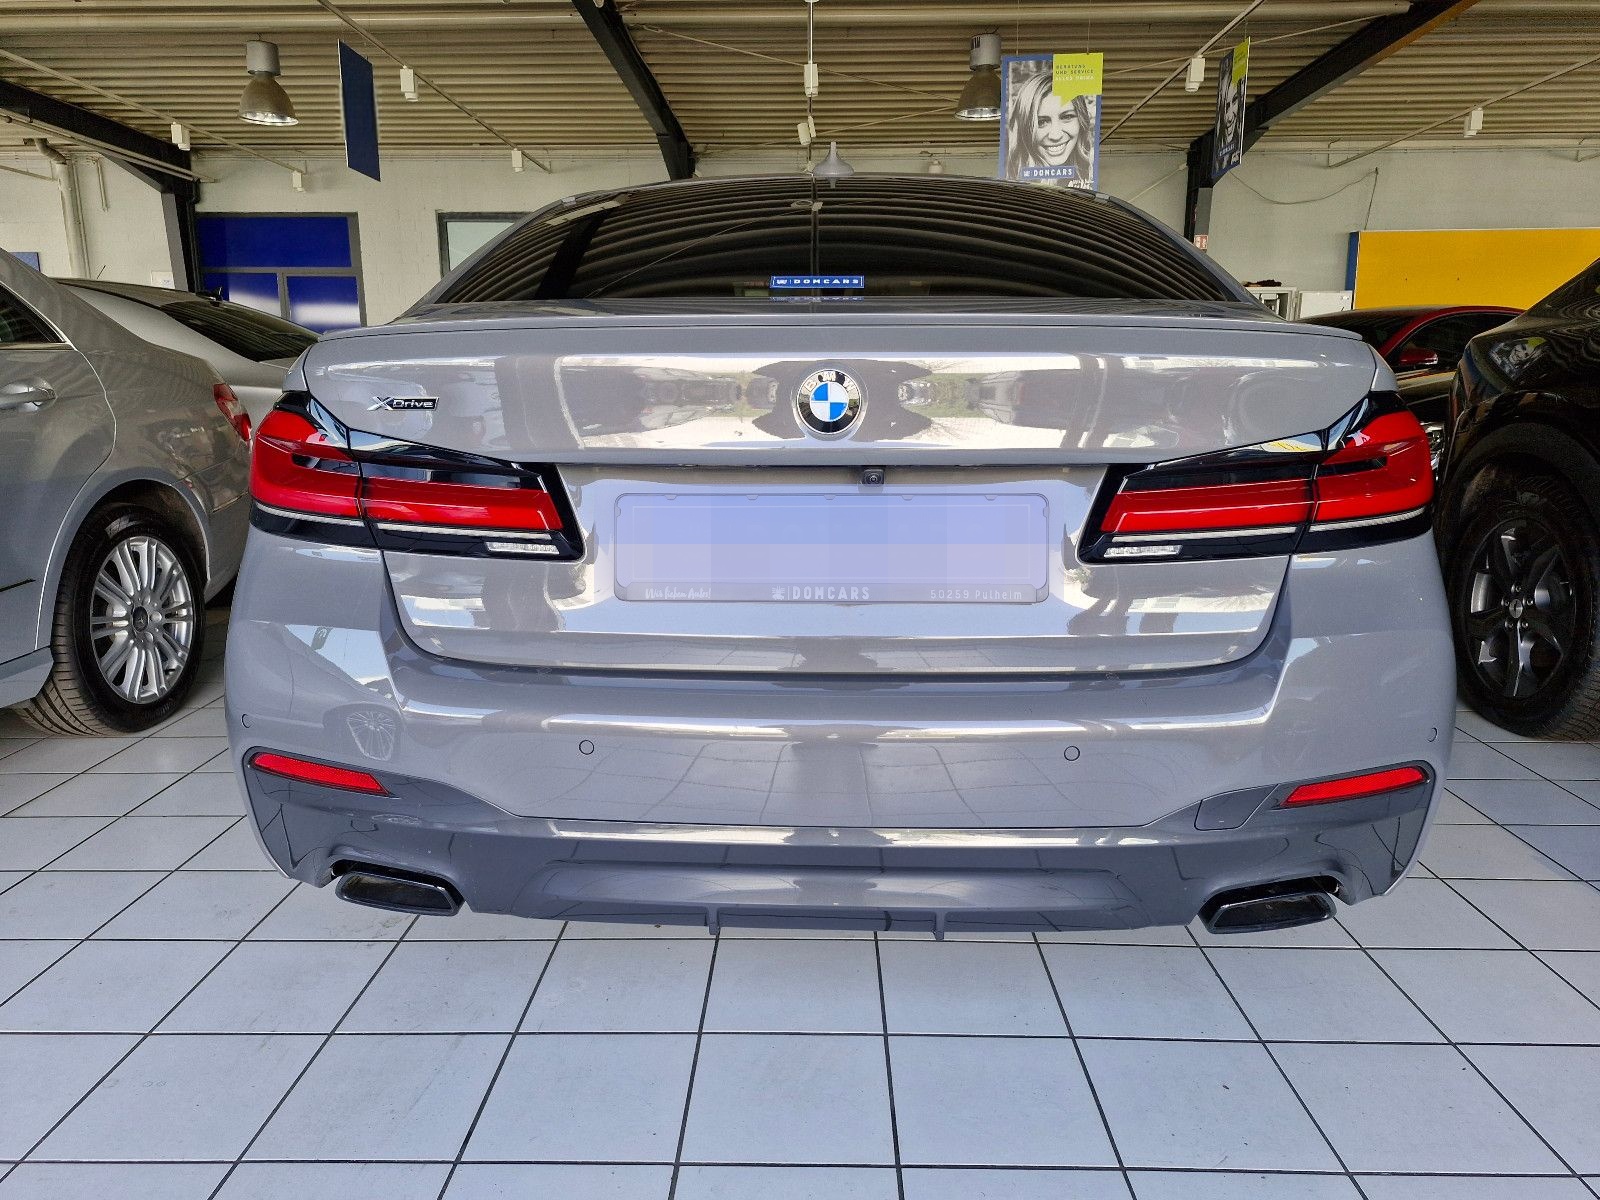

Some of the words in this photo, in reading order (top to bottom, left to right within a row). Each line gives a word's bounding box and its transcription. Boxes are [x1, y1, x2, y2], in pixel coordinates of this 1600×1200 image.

[1033, 168, 1073, 177] DOMCARS
[804, 371, 857, 391] BMW
[792, 585, 870, 600] DOMCARS
[930, 589, 970, 599] 50259
[975, 589, 1022, 600] Pulheim
